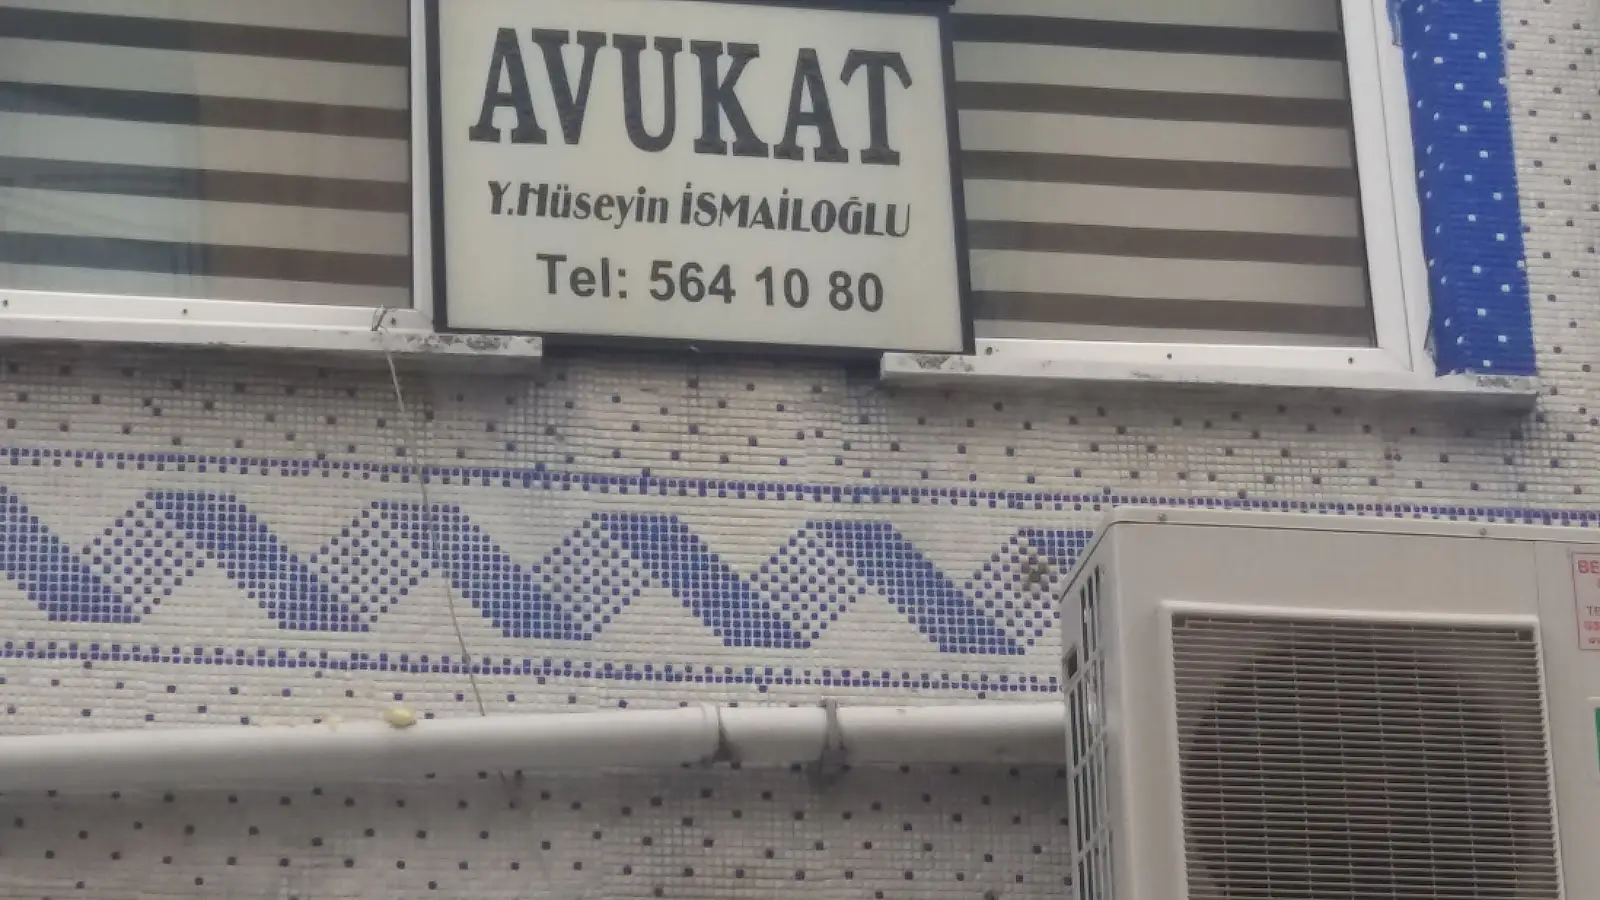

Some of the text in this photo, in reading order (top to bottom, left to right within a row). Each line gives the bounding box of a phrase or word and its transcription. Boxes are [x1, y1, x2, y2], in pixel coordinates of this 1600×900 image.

[469, 28, 912, 166] AVUKAT
[487, 180, 910, 238] Y.Hüseyin İSMAİLOĞLU
[535, 253, 884, 313] Tel: 564 10 80
